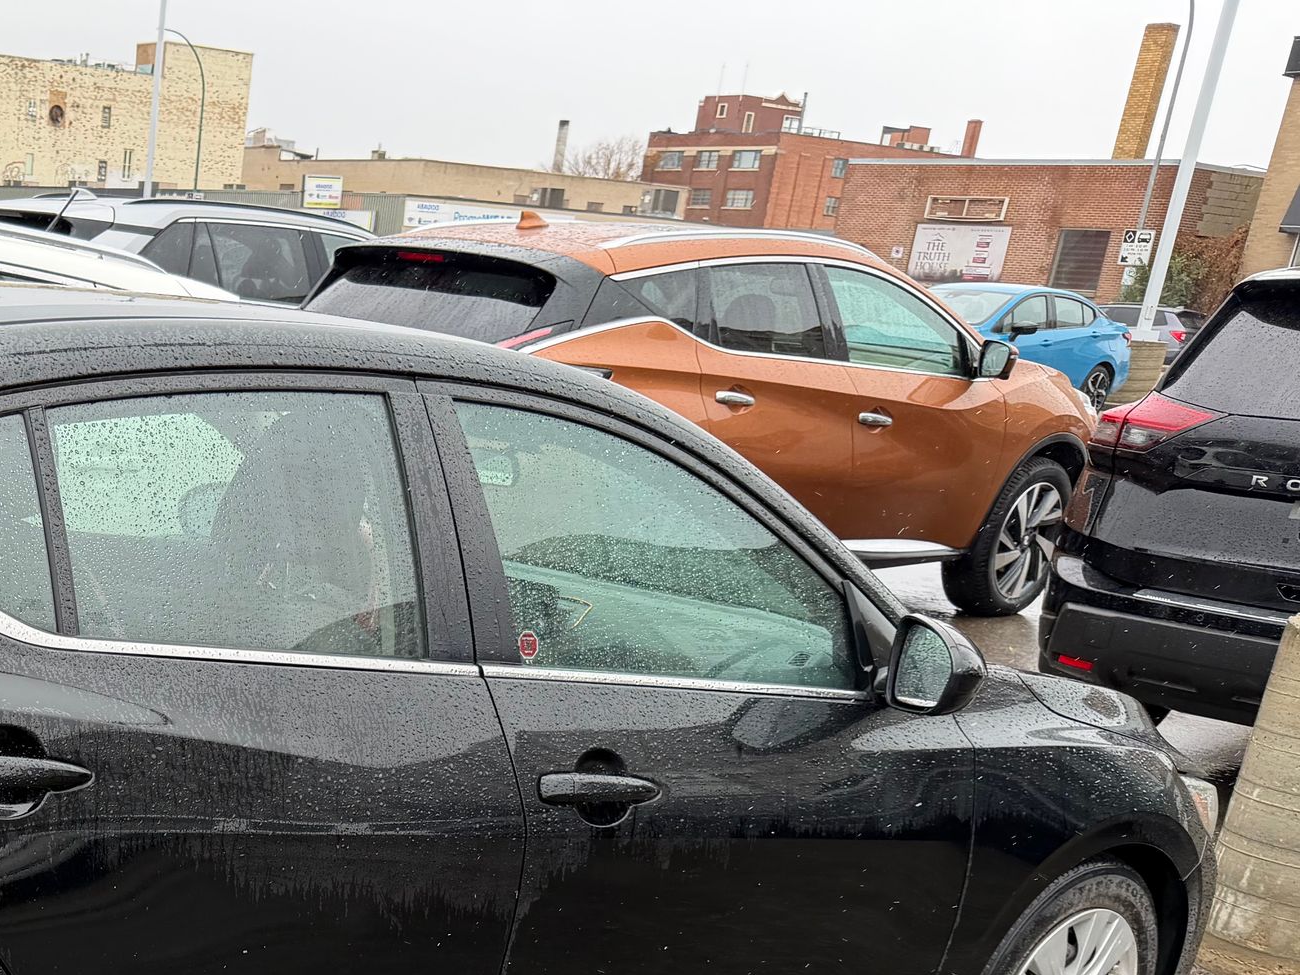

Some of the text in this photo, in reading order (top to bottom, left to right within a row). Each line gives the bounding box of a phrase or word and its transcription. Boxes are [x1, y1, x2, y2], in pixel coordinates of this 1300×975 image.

[926, 241, 947, 251] THE
[917, 251, 951, 261] TRUTH
[914, 261, 949, 271] HOUSE
